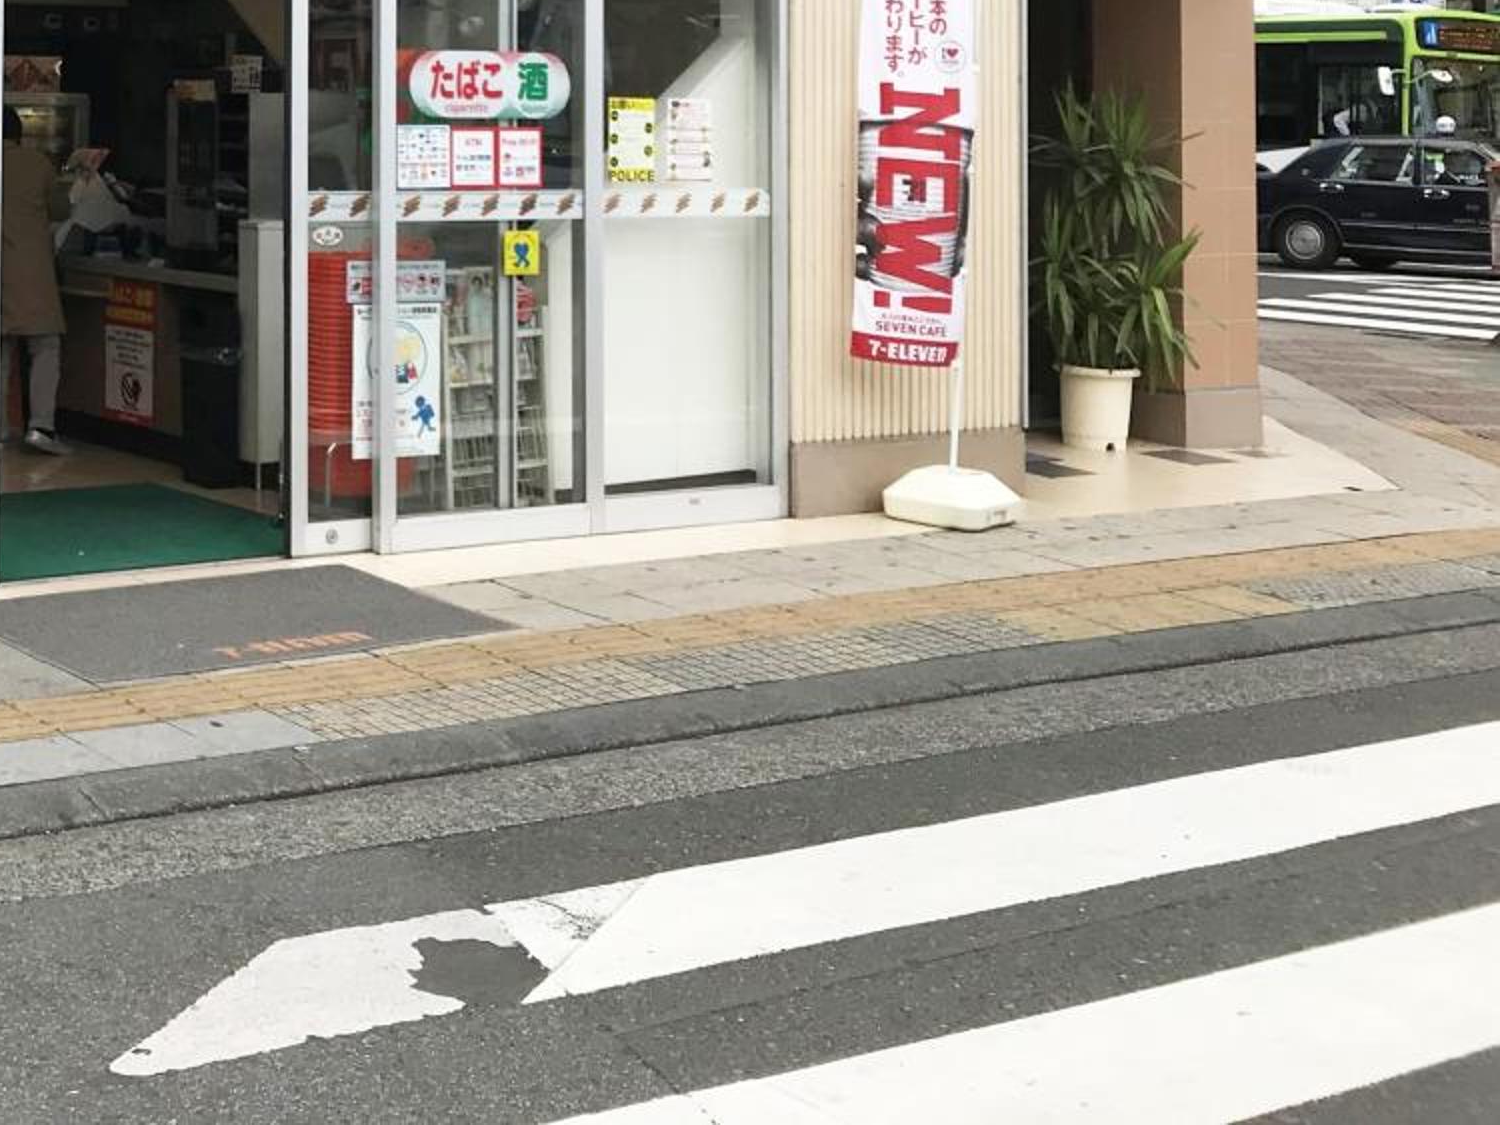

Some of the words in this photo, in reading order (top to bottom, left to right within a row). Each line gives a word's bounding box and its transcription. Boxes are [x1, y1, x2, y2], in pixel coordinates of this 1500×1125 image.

[431, 60, 503, 100] たばこ
[518, 62, 549, 101] 酒
[608, 169, 655, 182] POLICE
[873, 81, 961, 315] NEW!
